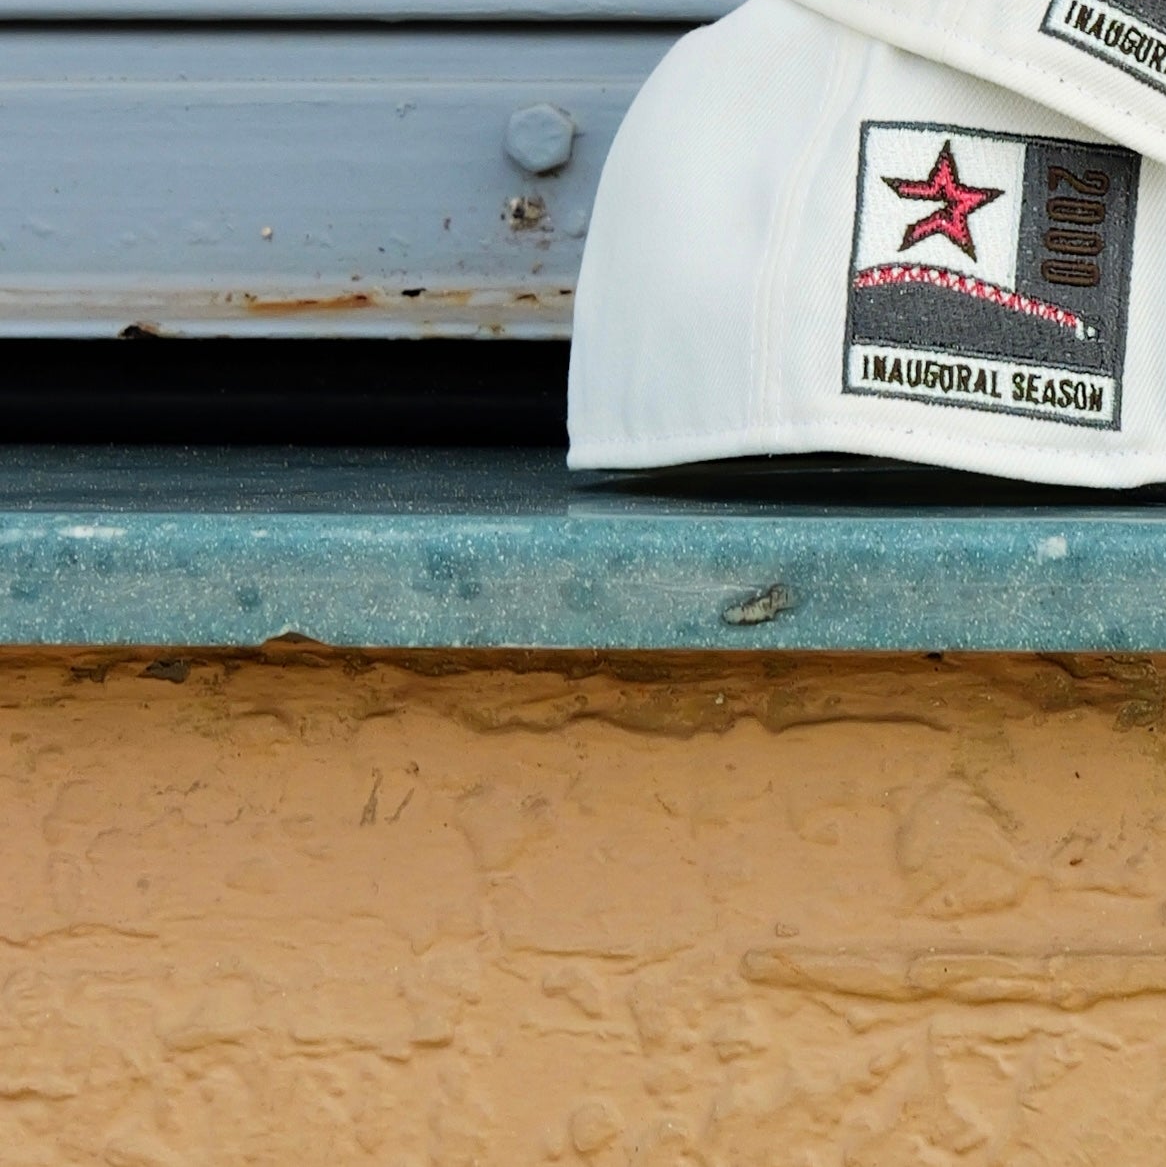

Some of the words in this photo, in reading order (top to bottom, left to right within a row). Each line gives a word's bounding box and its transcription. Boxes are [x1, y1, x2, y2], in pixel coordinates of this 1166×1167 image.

[1041, 165, 1110, 287] 2000
[861, 354, 1002, 399] INAUGURAL
[1012, 372, 1104, 412] SEASON
